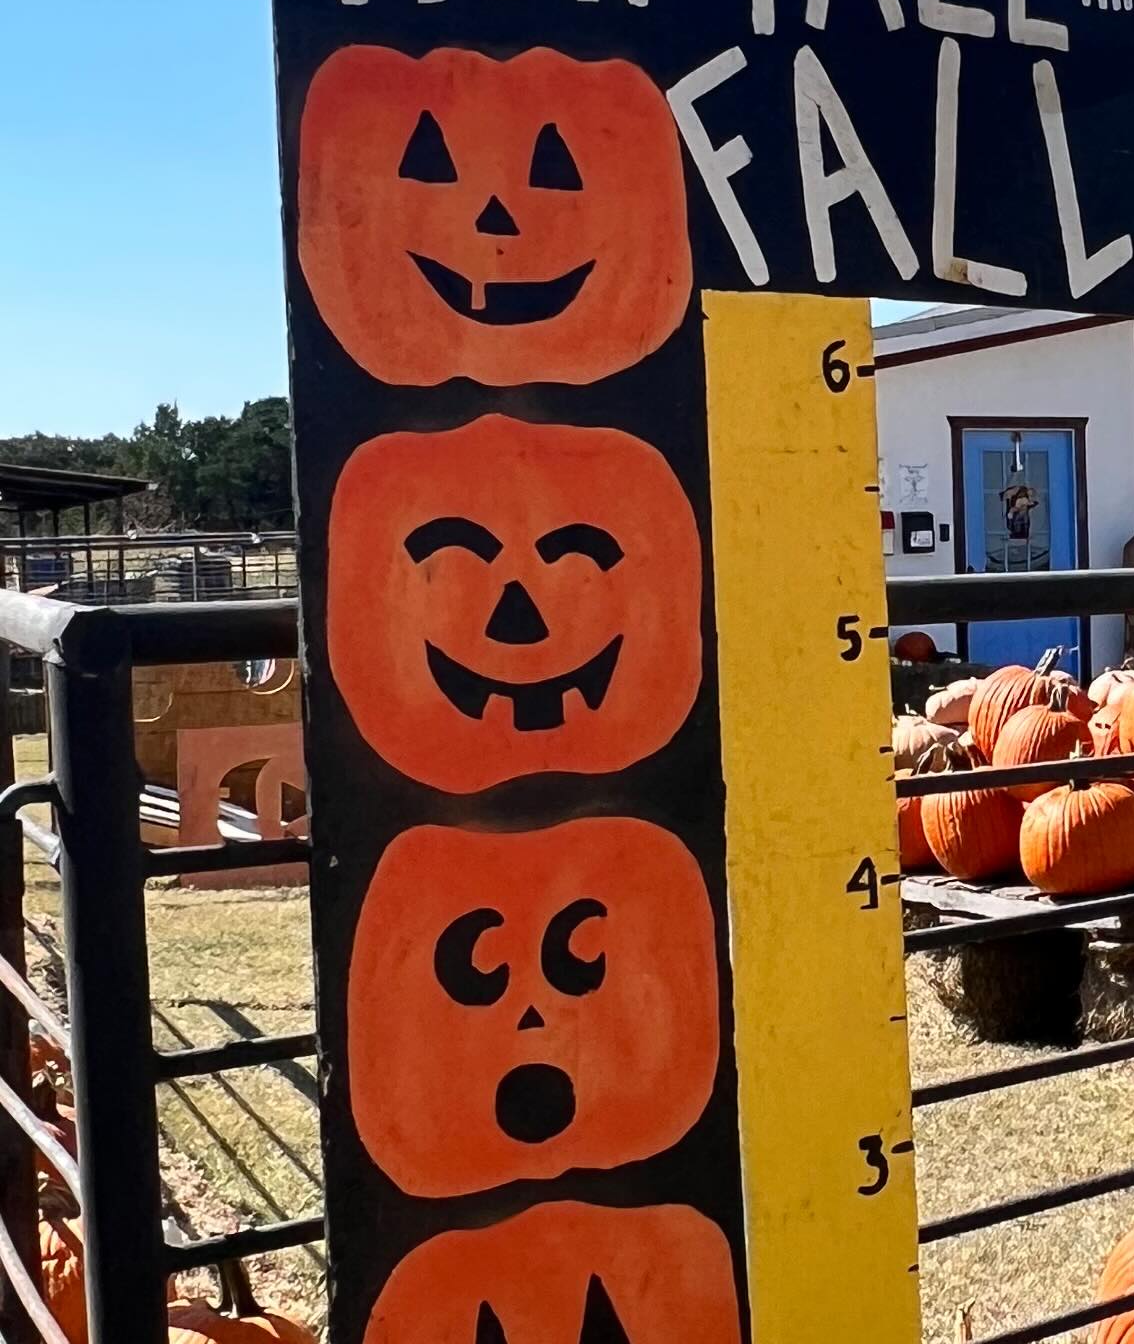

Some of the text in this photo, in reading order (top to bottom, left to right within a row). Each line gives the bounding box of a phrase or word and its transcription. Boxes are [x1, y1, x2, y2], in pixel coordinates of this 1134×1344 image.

[665, 36, 1133, 299] FALL
[822, 339, 851, 394] 6
[836, 614, 862, 662] 5
[846, 856, 879, 910] 4
[857, 1134, 890, 1196] 3
